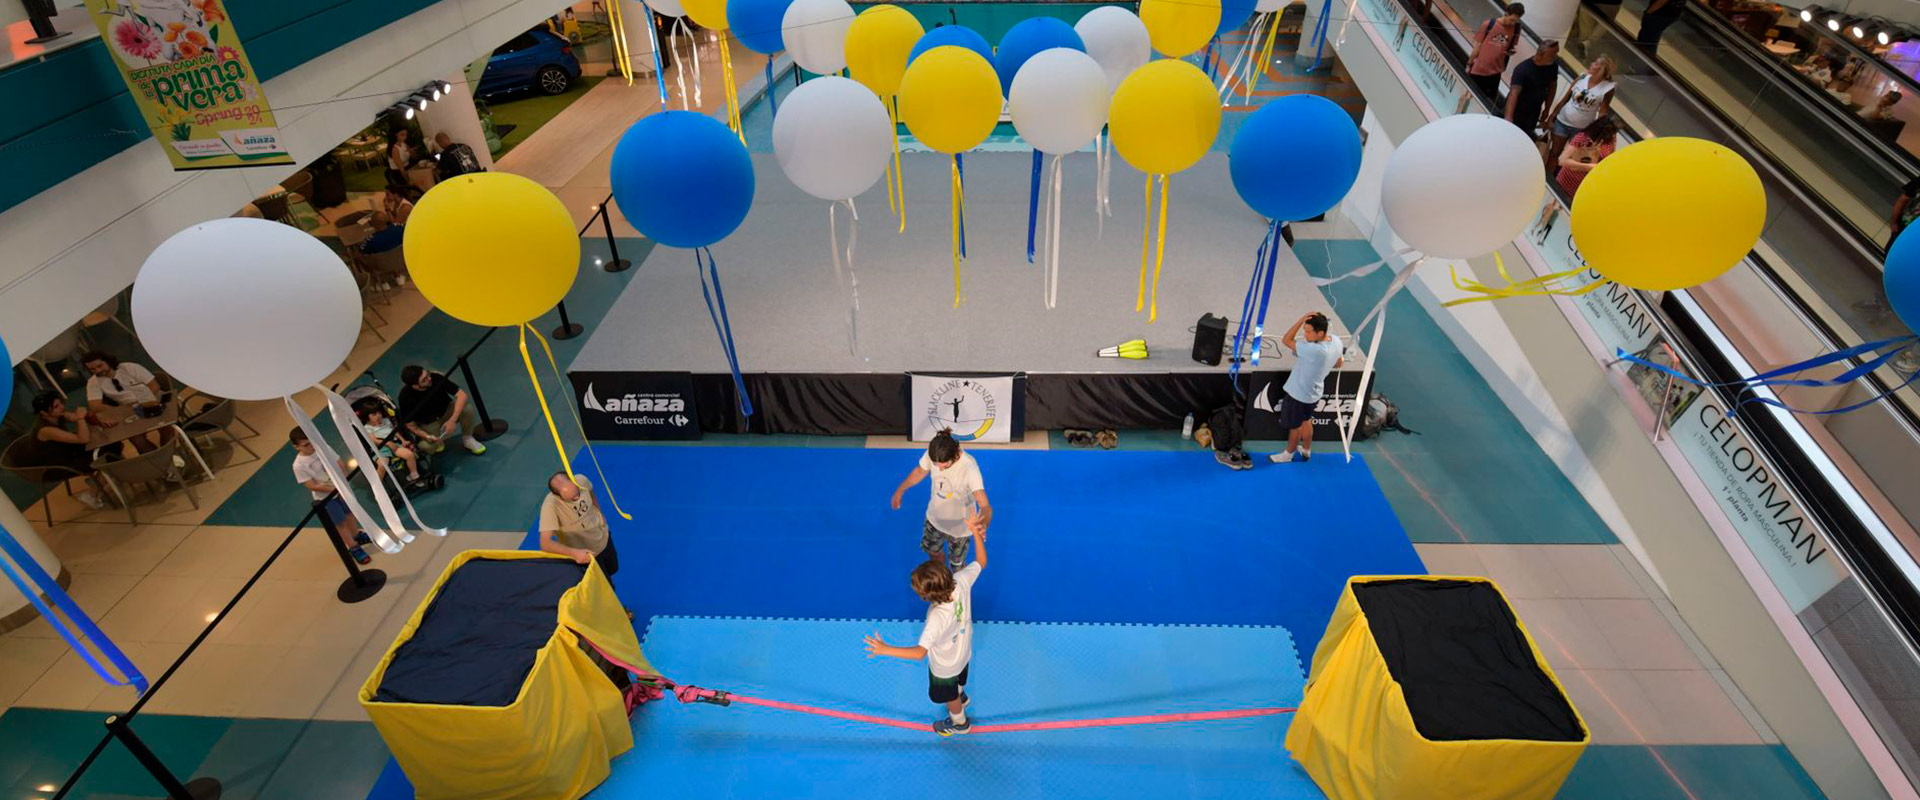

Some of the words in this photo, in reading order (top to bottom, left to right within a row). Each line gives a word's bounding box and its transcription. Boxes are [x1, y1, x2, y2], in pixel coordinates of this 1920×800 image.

[1412, 32, 1457, 93] CELOPMAN
[152, 60, 245, 107] prima
[172, 82, 244, 111] vera
[243, 135, 276, 145] añaza
[605, 393, 685, 412] añaza
[928, 380, 961, 415] SLACKLINE
[971, 381, 996, 417] TENERIFE
[614, 415, 665, 425] Carrefour
[1700, 404, 1827, 565] CELOPMAN
[1706, 446, 1728, 476] TIENDA
[1726, 474, 1738, 486] DE
[1736, 486, 1756, 511] ROPA
[1753, 509, 1793, 562] MASCULINA
[1727, 496, 1749, 522] planta
